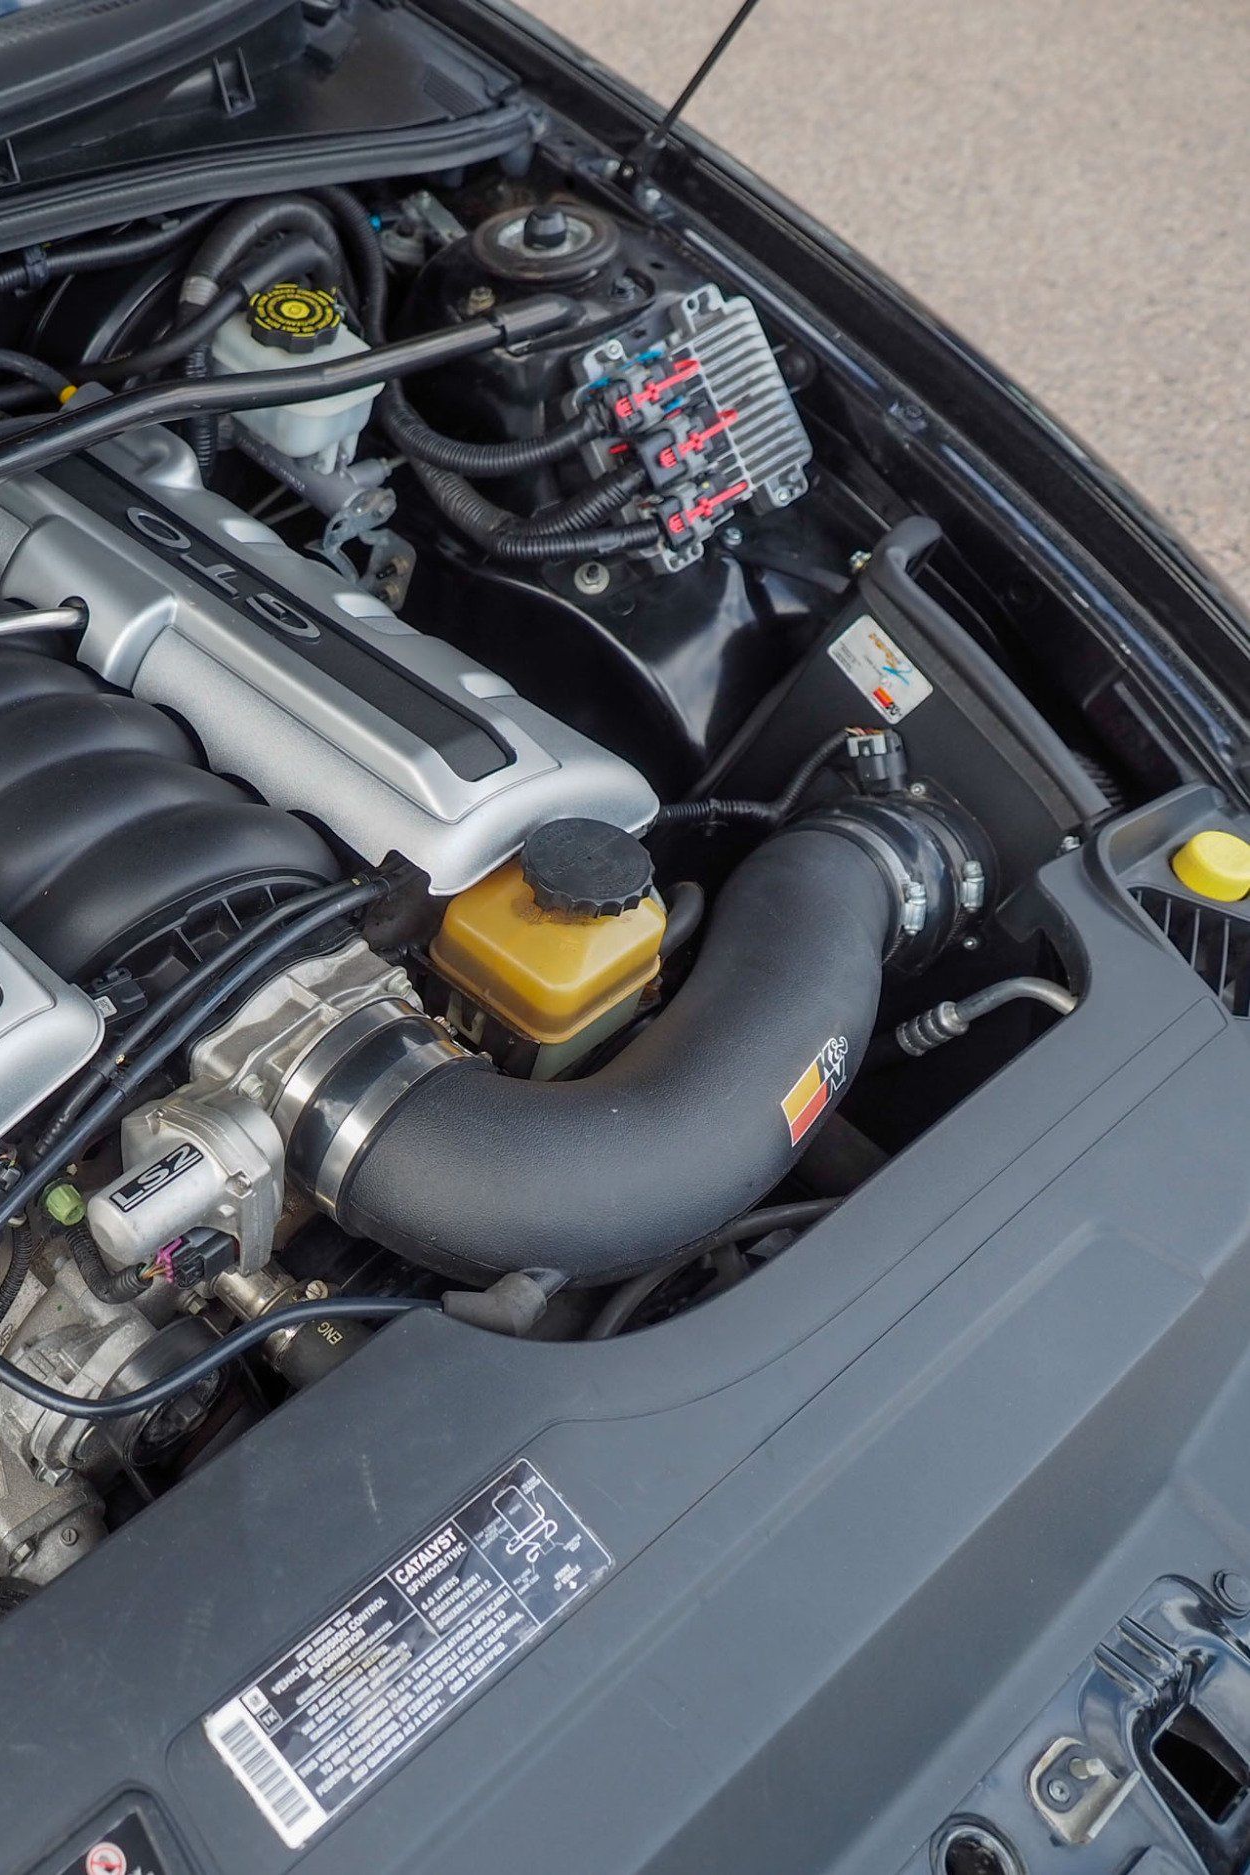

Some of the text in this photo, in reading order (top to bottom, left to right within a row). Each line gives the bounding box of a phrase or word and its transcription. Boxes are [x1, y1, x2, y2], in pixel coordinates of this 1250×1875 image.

[127, 507, 321, 638] GTO
[112, 1145, 199, 1207] LS2
[316, 1321, 343, 1345] ENG
[391, 1527, 461, 1586] CATALYST
[402, 1540, 470, 1597] SFI/HO2S/TWC
[431, 1574, 461, 1601] LITERS
[469, 1588, 511, 1627] APPLICABLE
[493, 1608, 506, 1622] TO
[270, 1594, 388, 1697] VEHICLE EMISSION CONTROL
[307, 1626, 366, 1680] INFORMATION
[455, 1651, 476, 1672] SALE
